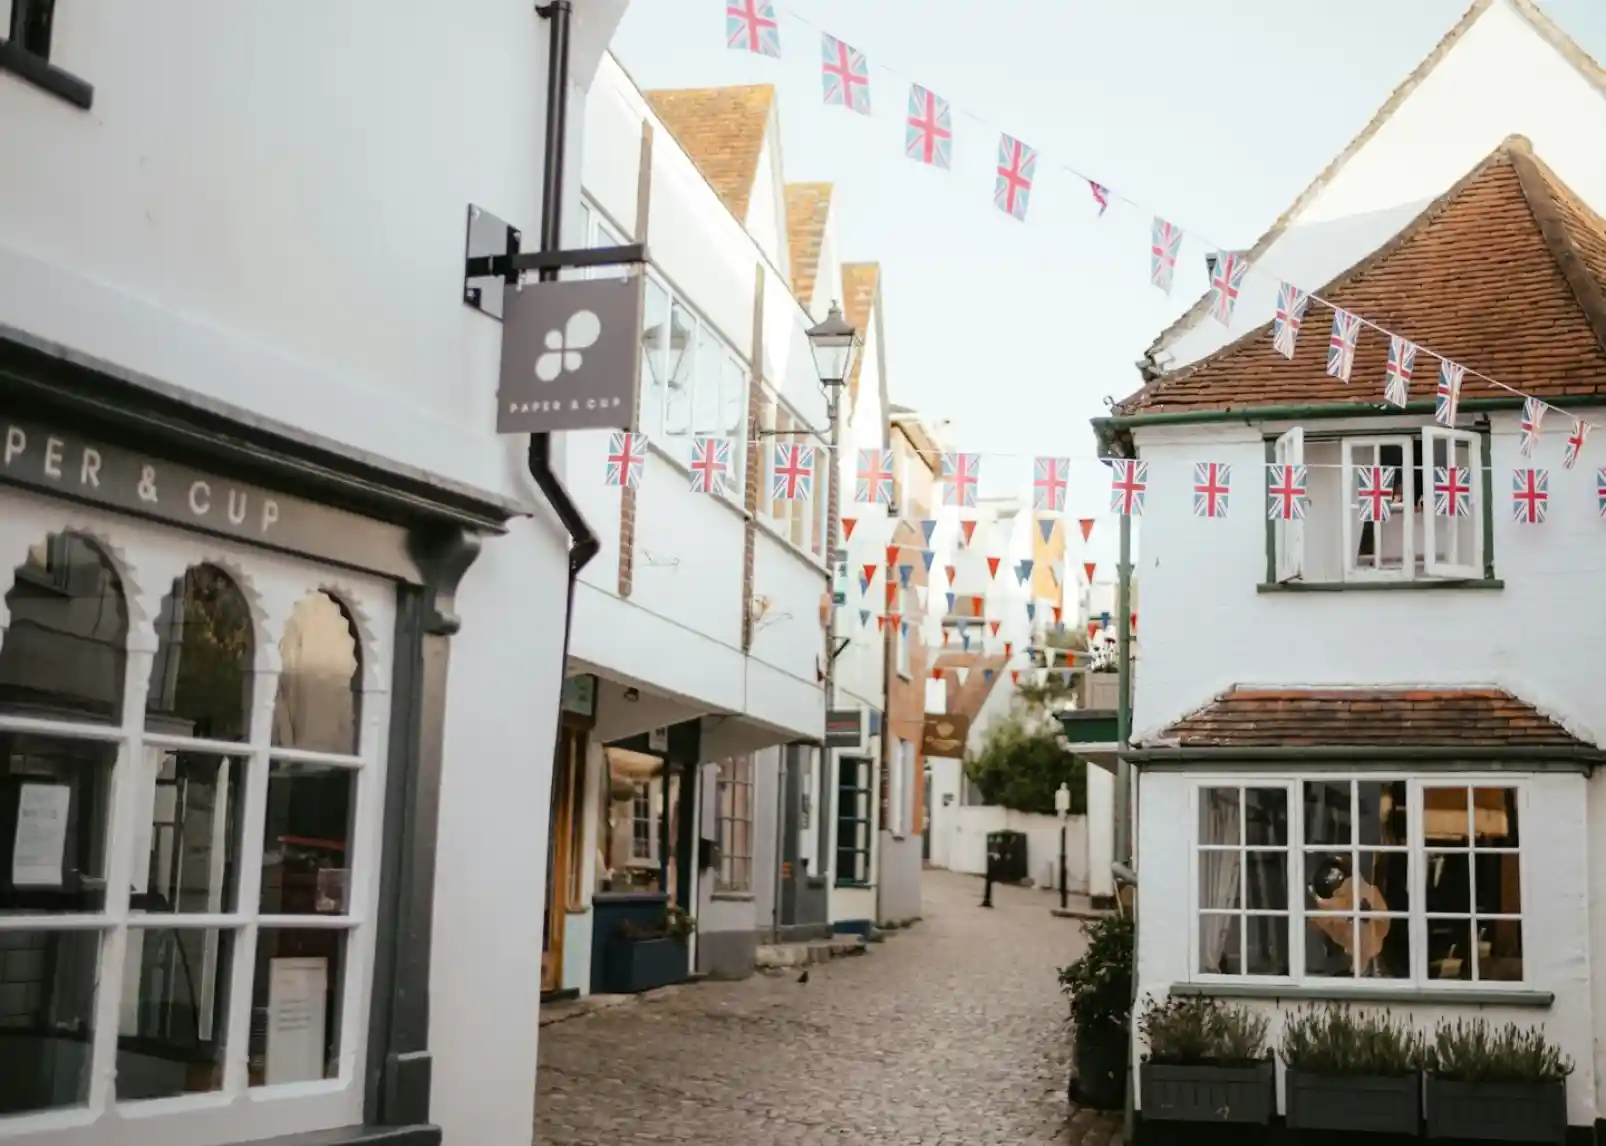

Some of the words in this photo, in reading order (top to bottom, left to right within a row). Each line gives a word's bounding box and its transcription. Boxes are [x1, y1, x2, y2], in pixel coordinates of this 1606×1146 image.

[509, 400, 561, 414] PAPER
[570, 399, 580, 411] &
[585, 396, 621, 411] CUP
[4, 424, 102, 488] PER
[137, 465, 158, 503] &
[188, 480, 279, 534] CUP
